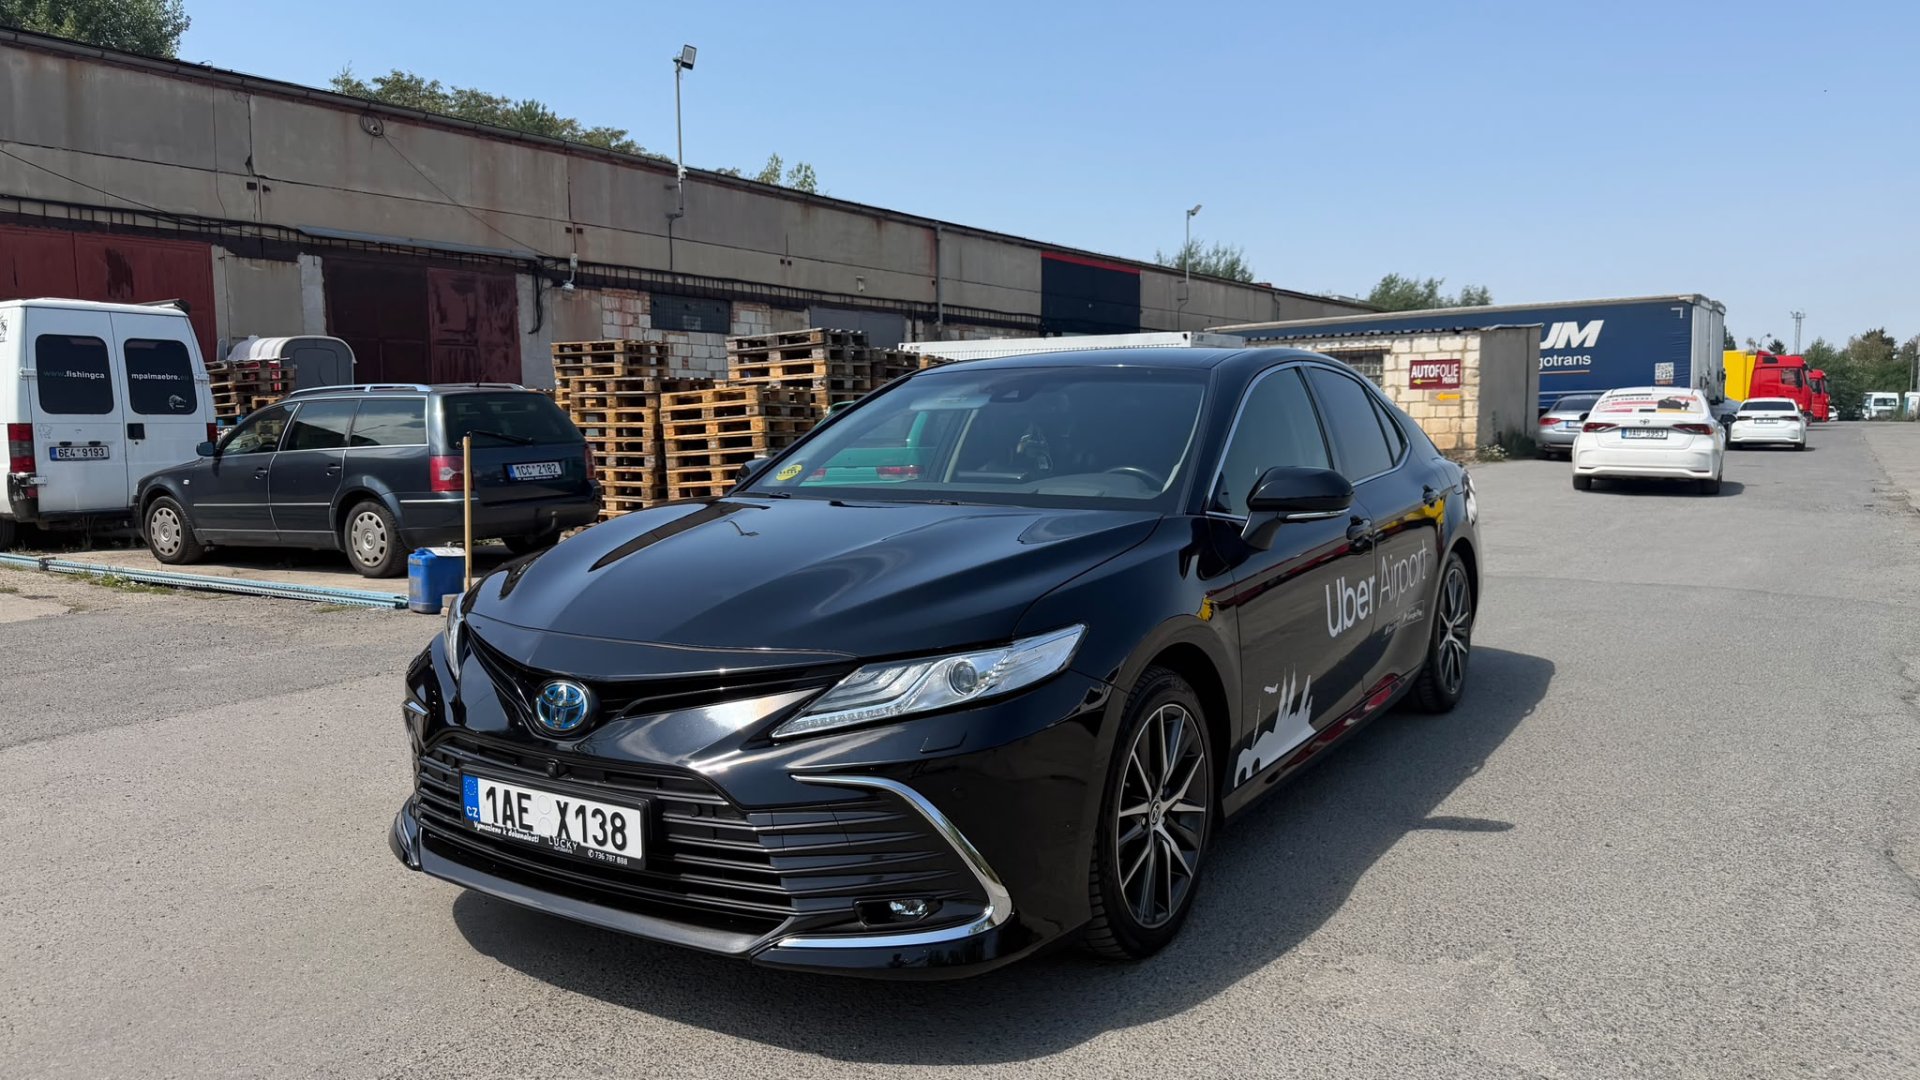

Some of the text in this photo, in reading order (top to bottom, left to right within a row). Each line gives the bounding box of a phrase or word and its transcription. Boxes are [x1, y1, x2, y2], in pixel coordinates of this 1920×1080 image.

[1411, 363, 1459, 378] AUTOFOLIE
[58, 447, 104, 458] 6E4 9193
[516, 463, 558, 476] 1CC 2182
[1325, 575, 1375, 637] Uber
[1379, 539, 1427, 608] Airport
[466, 806, 478, 818] CZ
[486, 786, 627, 851] 1AE X138
[548, 835, 578, 850] LUCKY
